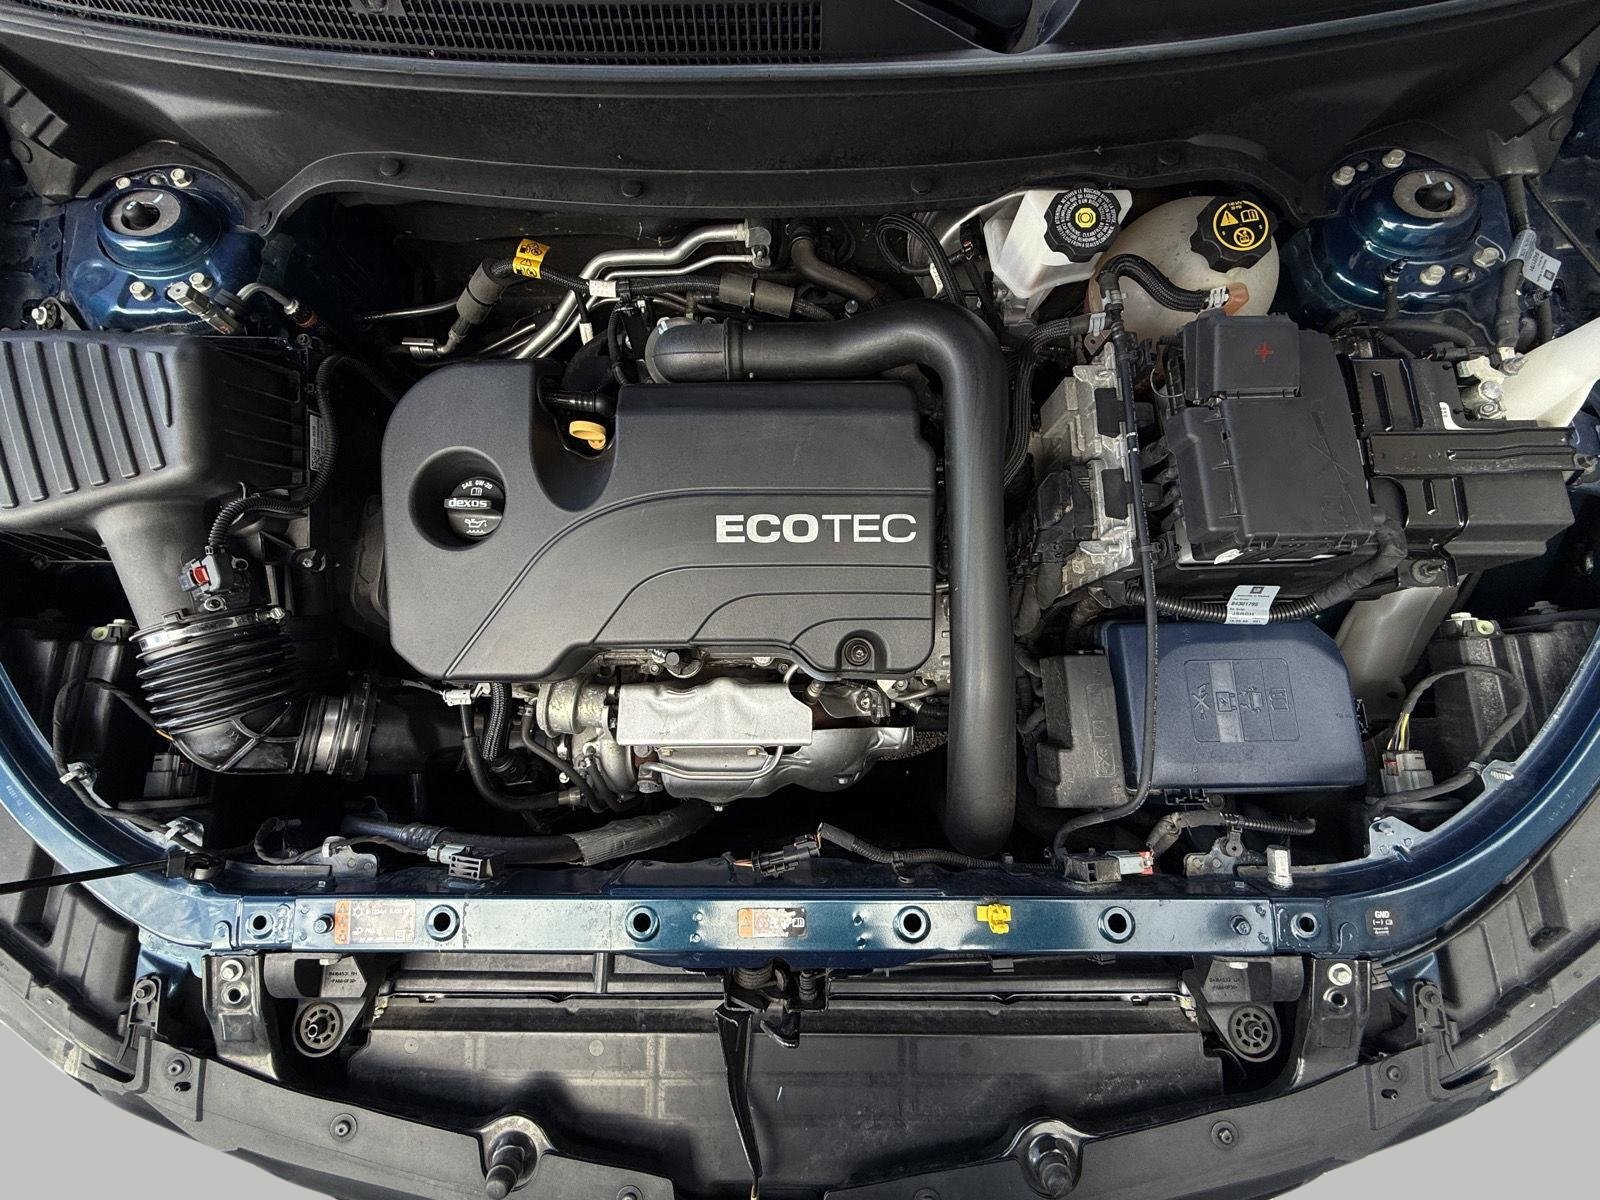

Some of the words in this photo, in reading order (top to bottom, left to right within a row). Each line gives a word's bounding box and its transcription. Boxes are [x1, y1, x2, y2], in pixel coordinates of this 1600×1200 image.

[462, 480, 472, 490] SAE
[448, 498, 487, 508] dexos
[716, 514, 916, 543] ECOTEC
[1374, 910, 1390, 918] GND
